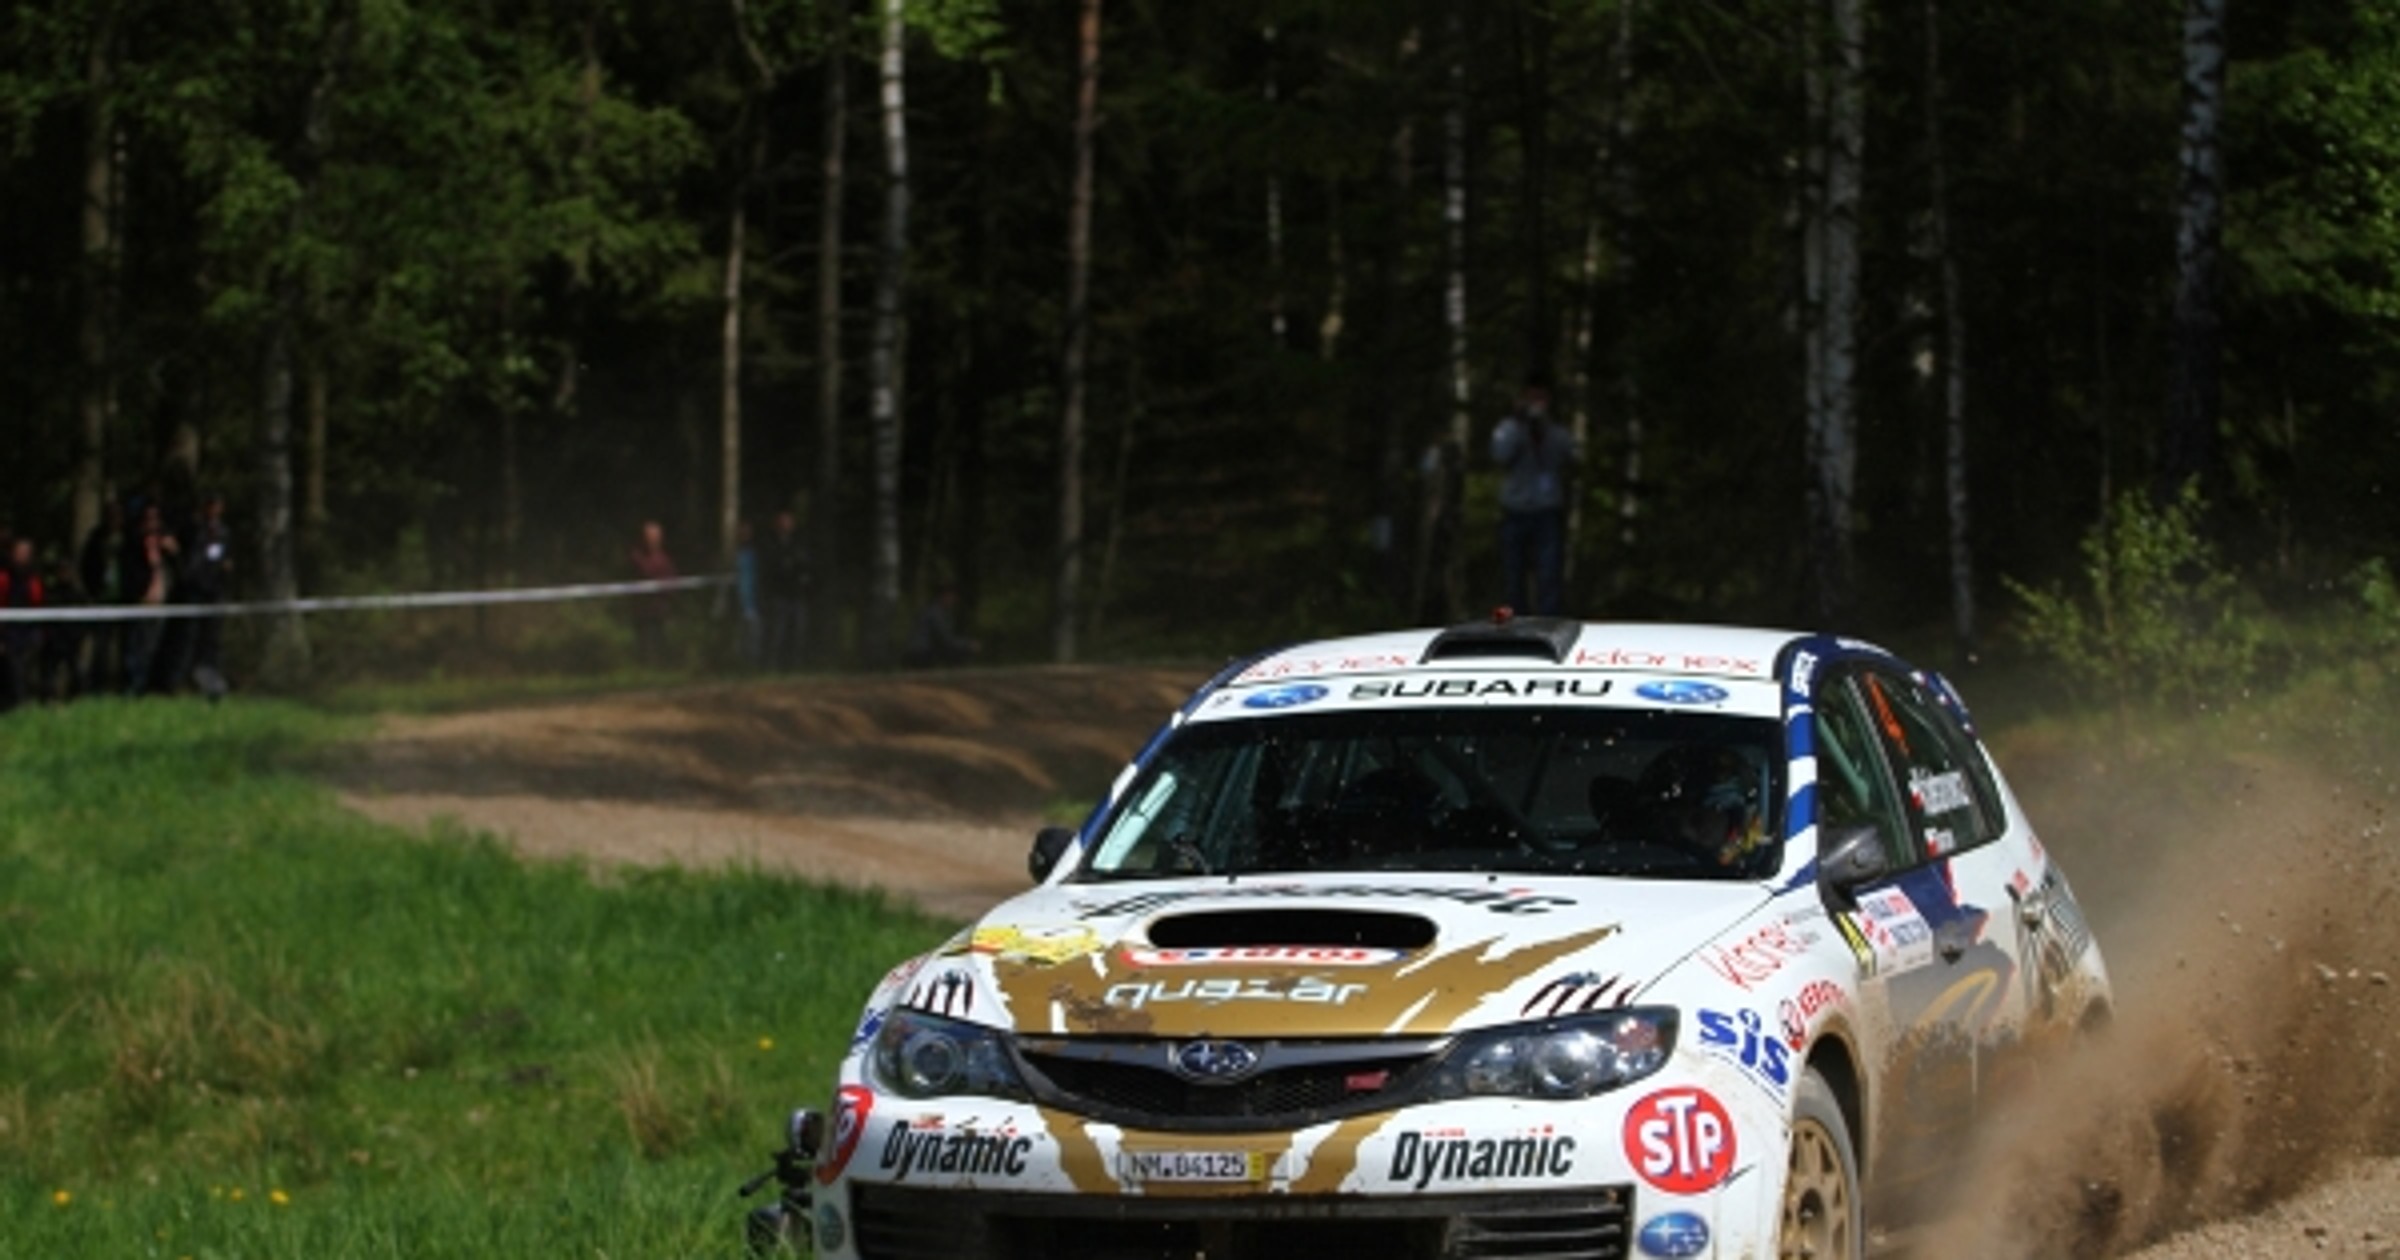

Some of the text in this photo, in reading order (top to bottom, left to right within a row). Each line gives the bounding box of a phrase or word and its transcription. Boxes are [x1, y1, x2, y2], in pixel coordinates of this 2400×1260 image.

[1348, 678, 1613, 701] SUBARU
[880, 1119, 1032, 1181] Dynamic
[1388, 1125, 1576, 1189] Dynamic
[1637, 1095, 1723, 1178] STP
